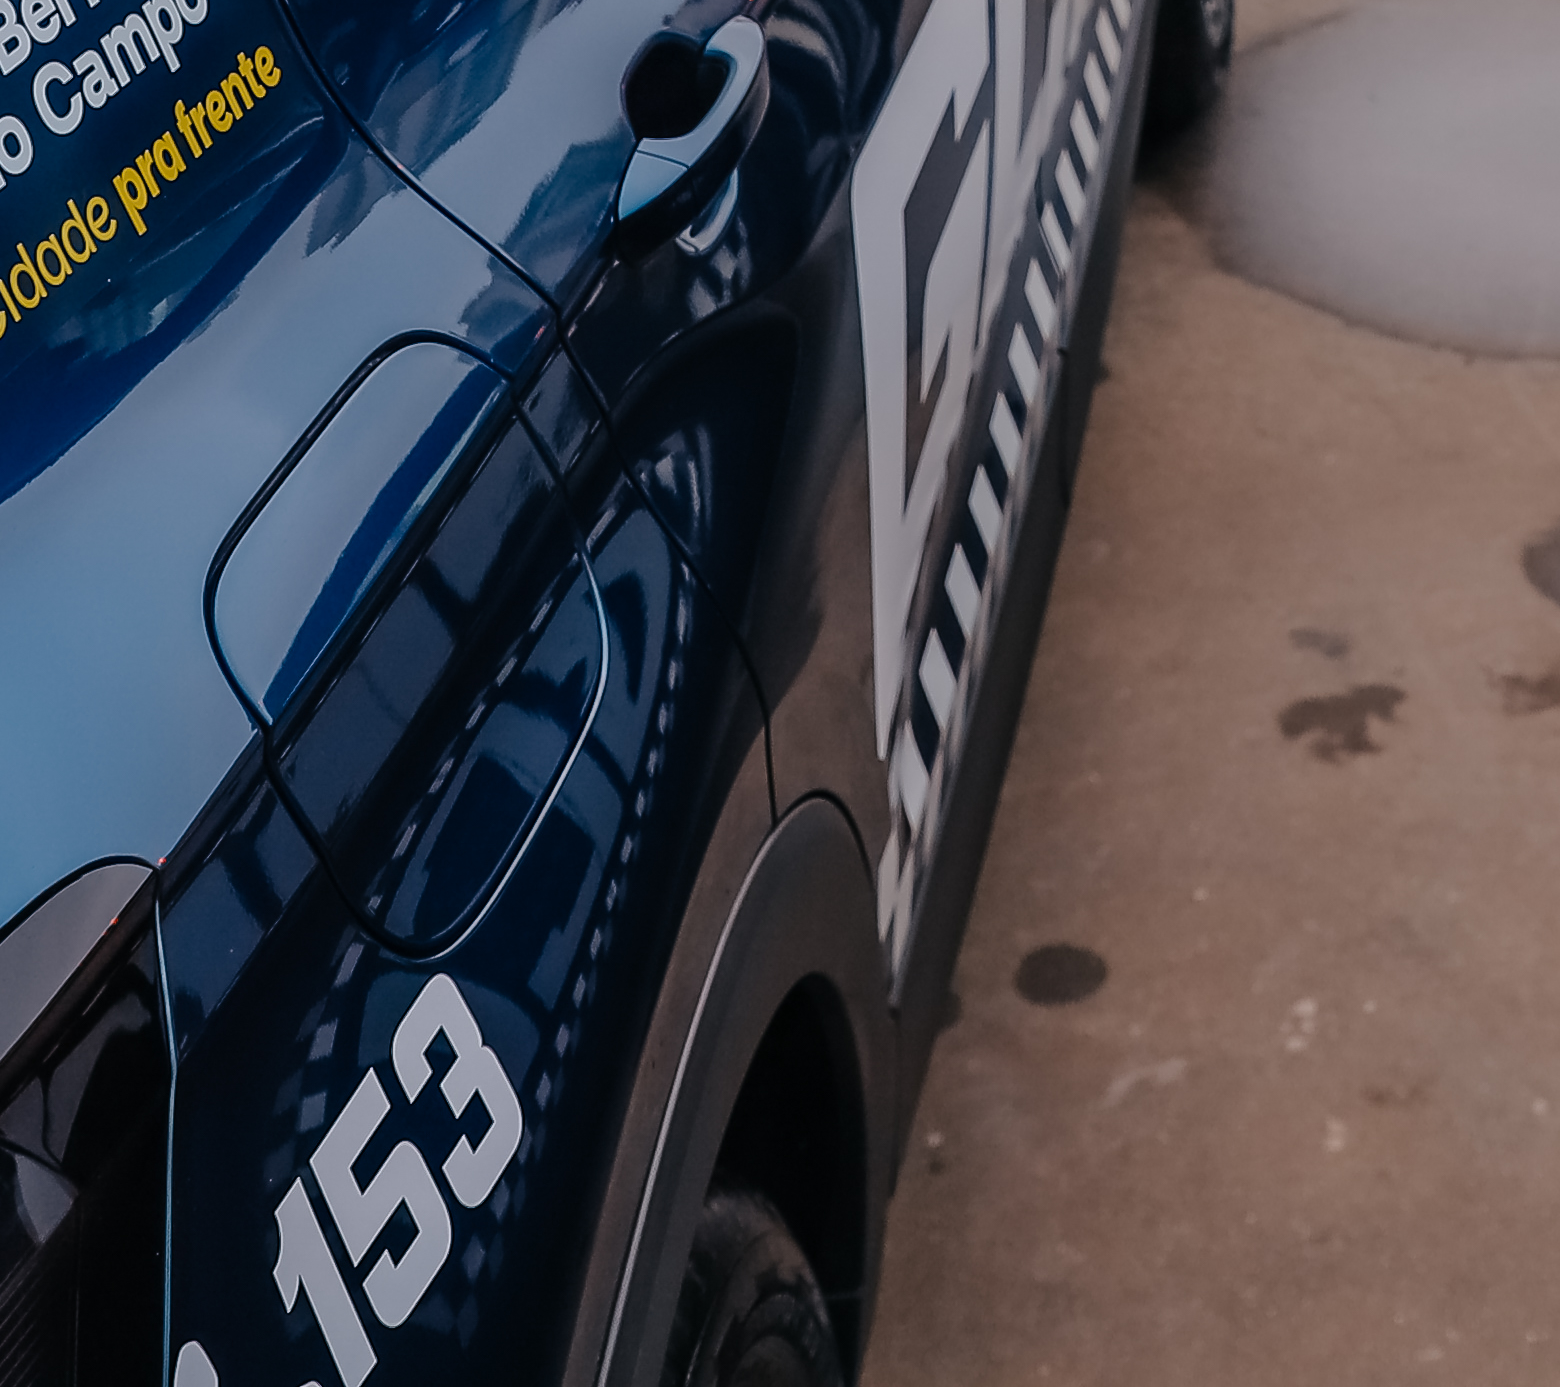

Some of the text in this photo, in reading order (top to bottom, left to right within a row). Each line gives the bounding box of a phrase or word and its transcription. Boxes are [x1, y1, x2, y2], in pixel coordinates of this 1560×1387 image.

[113, 134, 185, 234] pra
[175, 46, 282, 158] frente
[273, 973, 523, 1387] 153
